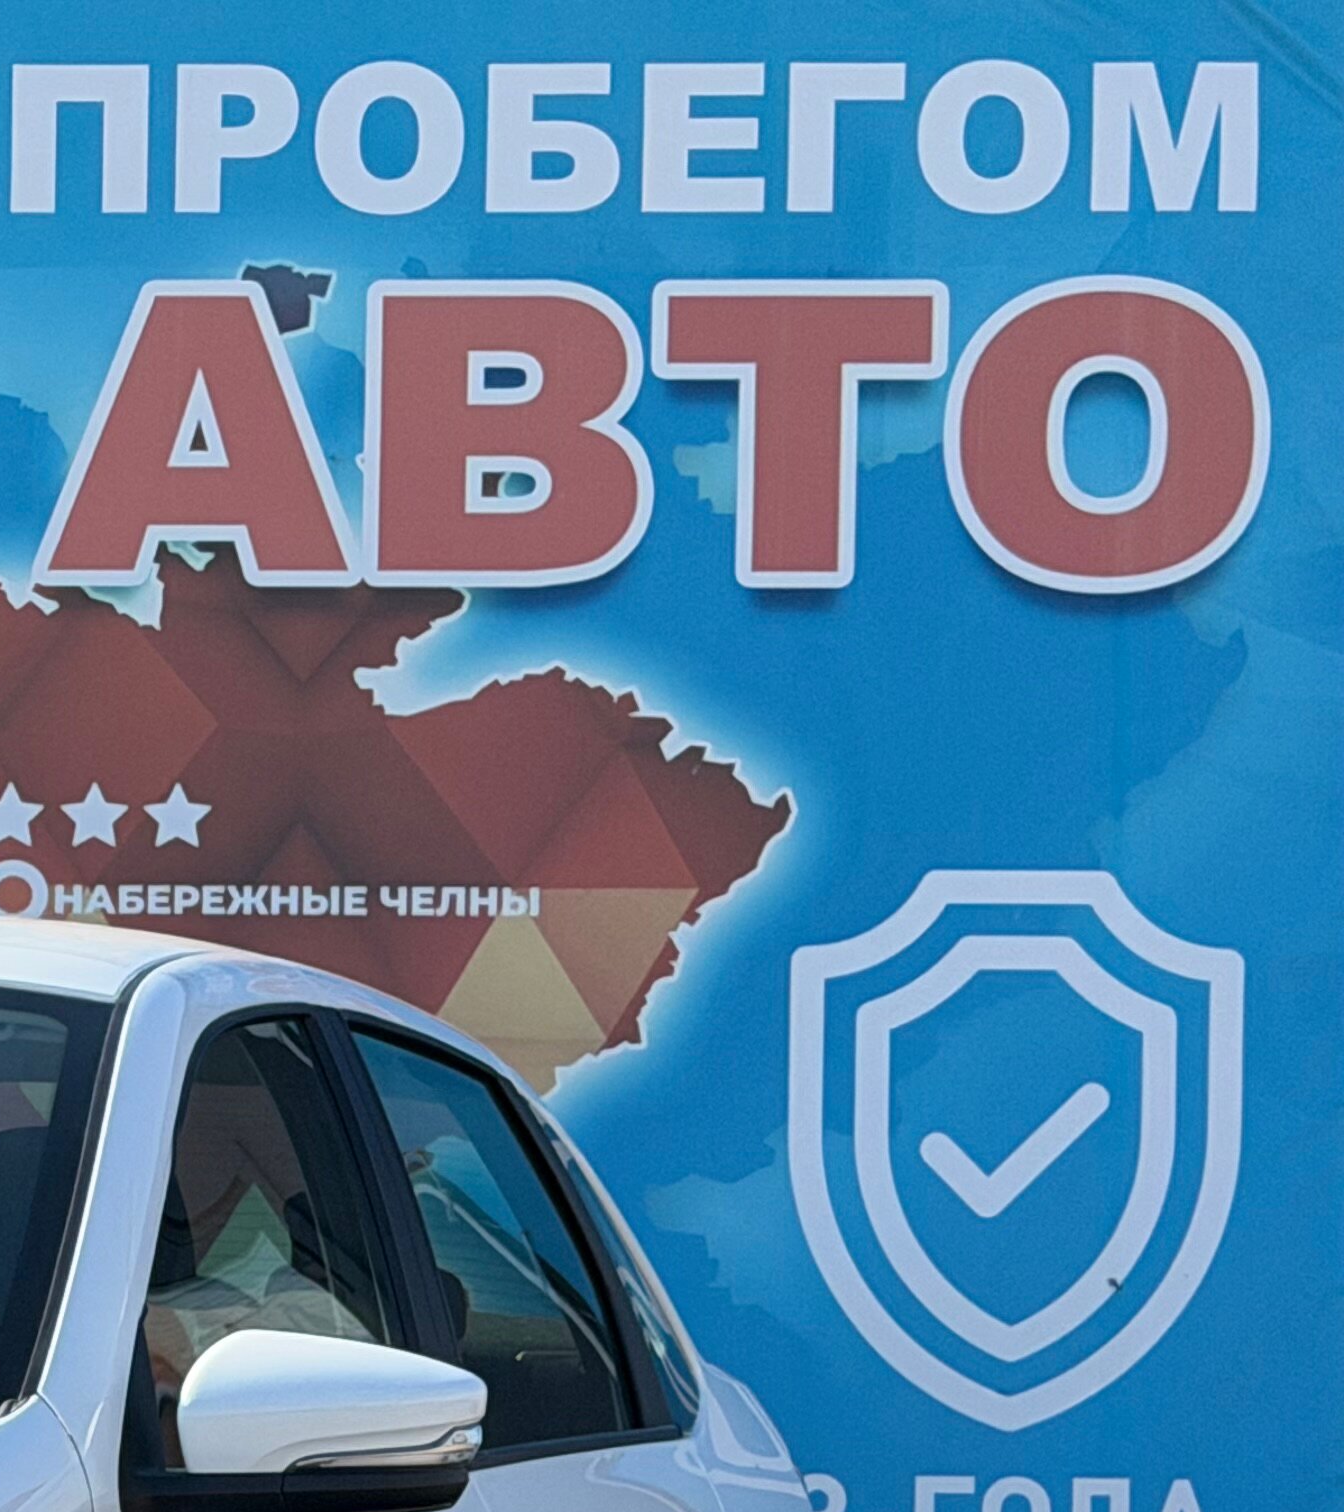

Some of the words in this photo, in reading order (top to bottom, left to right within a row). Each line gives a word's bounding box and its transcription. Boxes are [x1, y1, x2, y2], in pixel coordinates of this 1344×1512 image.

[10, 60, 1259, 215] ПРОБЕГОМ
[32, 275, 1271, 594] АВТО
[54, 883, 368, 917] НАБЕРЕЖНЫЕ
[380, 885, 540, 918] ЧЕЛНЫ
